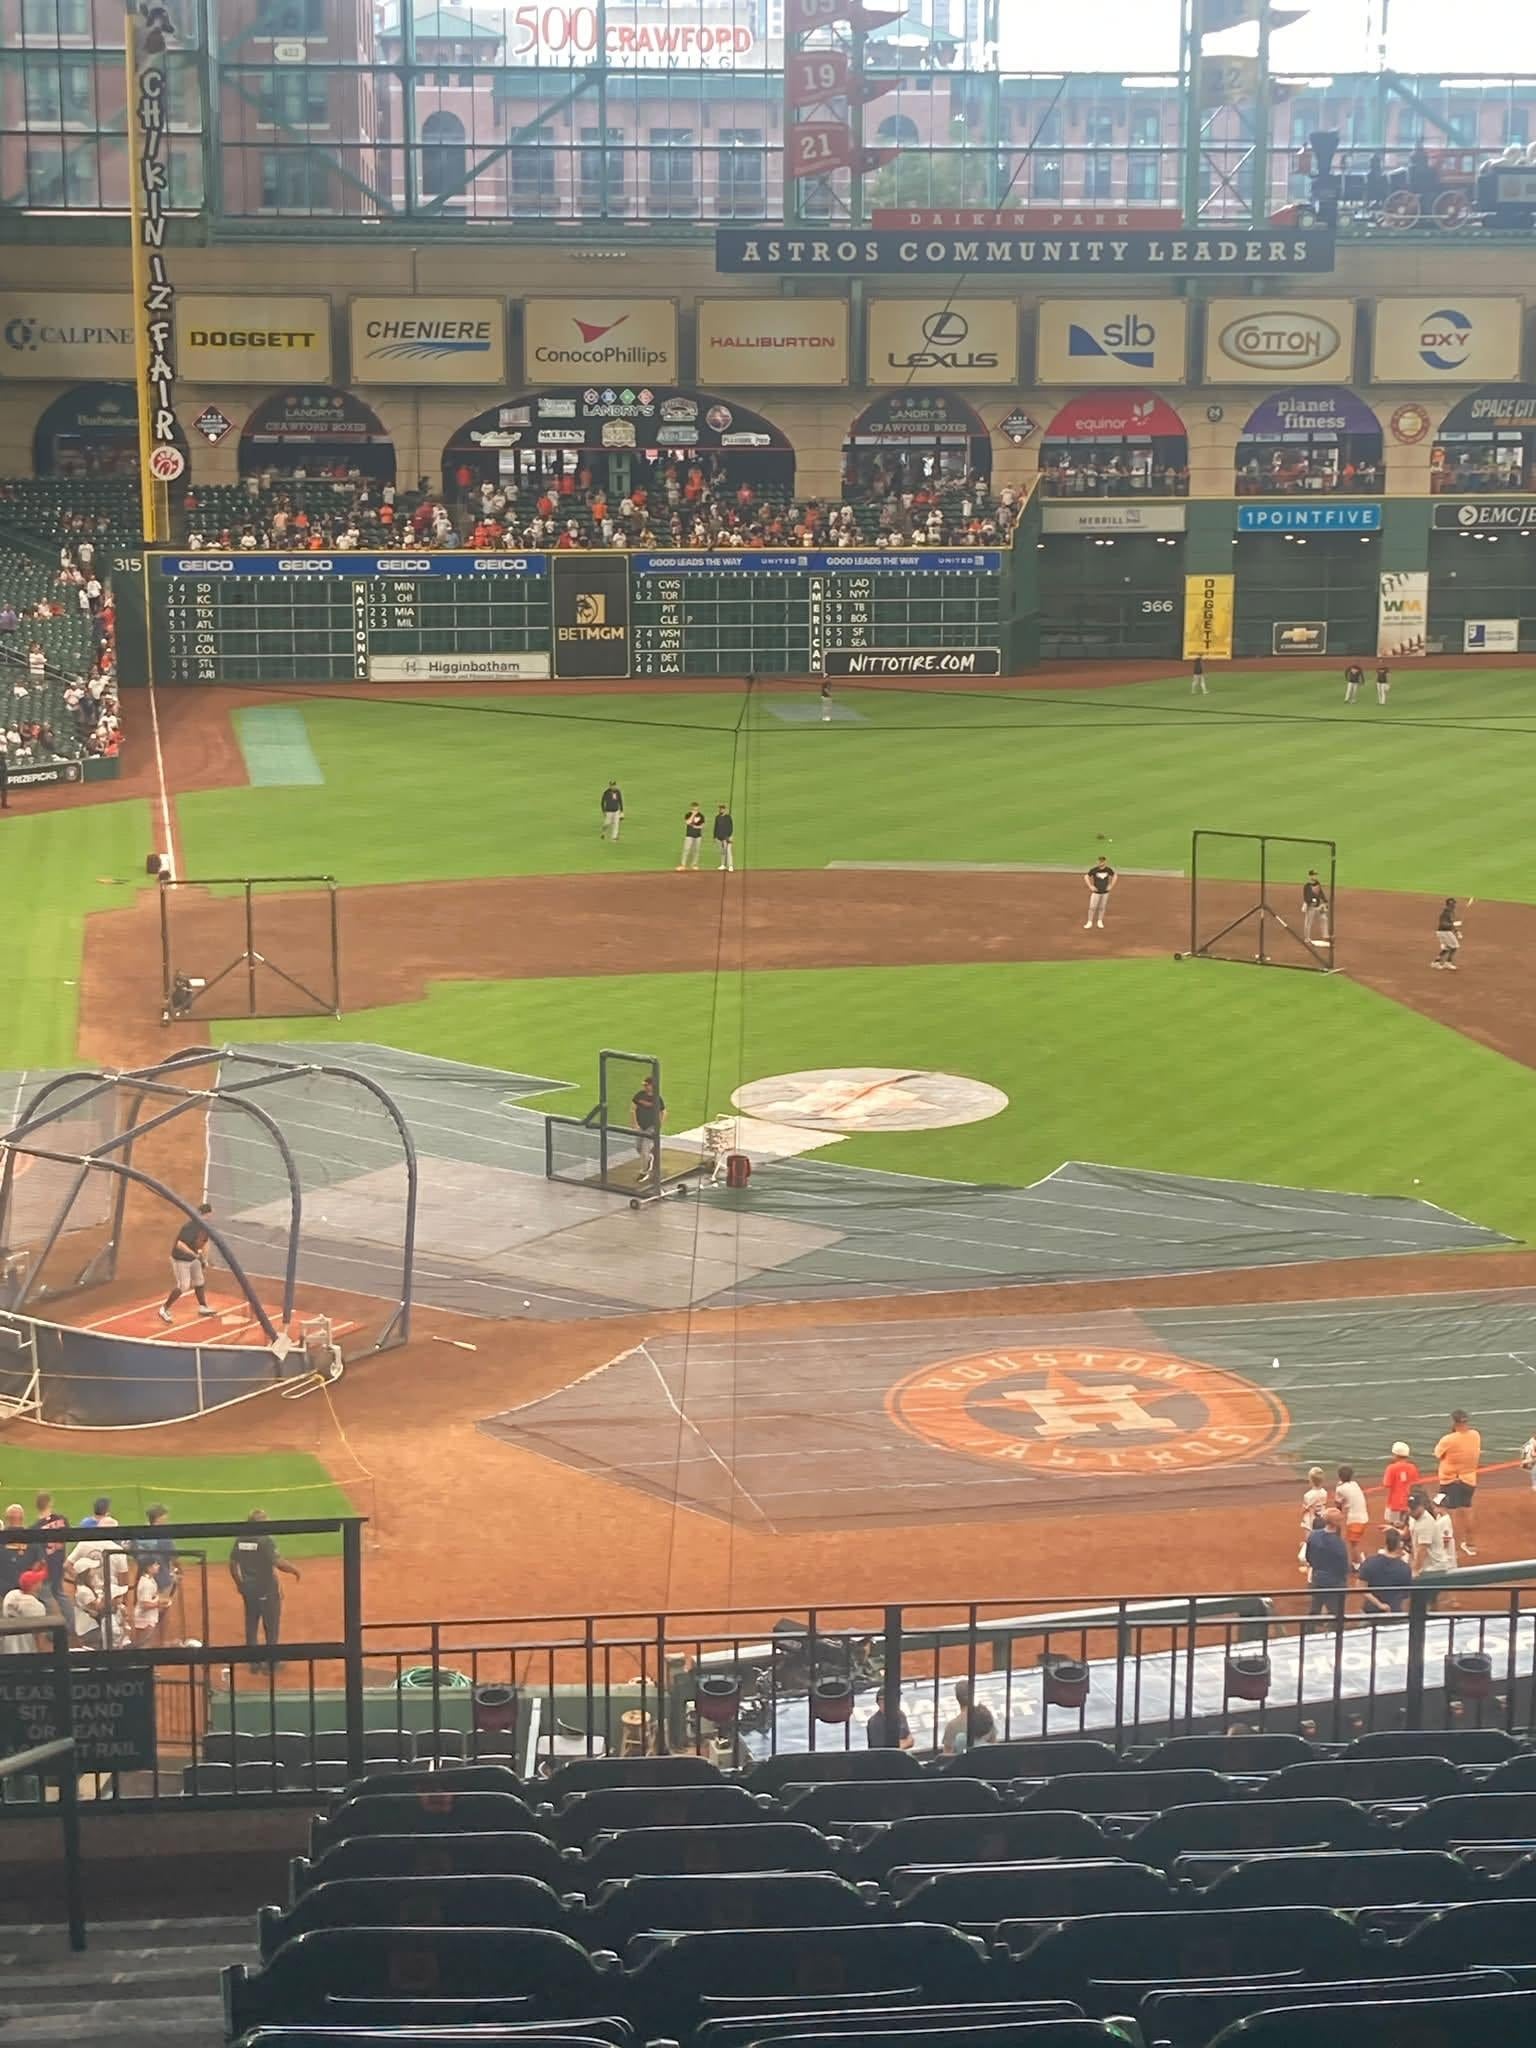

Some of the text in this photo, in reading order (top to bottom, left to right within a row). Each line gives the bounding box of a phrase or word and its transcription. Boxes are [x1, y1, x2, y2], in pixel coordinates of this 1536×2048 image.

[514, 5, 752, 54] 500 CRAWFORD
[803, 63, 835, 90] 19
[800, 133, 833, 160] 21
[141, 70, 166, 248] CHIKIN
[910, 213, 1130, 226] DAIKIN PARK
[742, 241, 1309, 262] ASTROS COMMUNITY LEADERS
[40, 327, 134, 344] CALPINE
[366, 321, 491, 339] CHENIERE
[1103, 314, 1156, 347] slb
[190, 331, 316, 348] DOGGETT
[710, 335, 836, 348] HALLIBURTON
[1233, 325, 1322, 357] COTTON
[1420, 332, 1469, 346] OXY
[535, 346, 668, 366] ConocoPhillips
[888, 352, 999, 369] LEXUS
[285, 408, 345, 419] LANDRY'S
[582, 404, 656, 417] LANDRY'S
[1277, 398, 1335, 417] planet
[1471, 400, 1514, 418] SPACE
[869, 423, 968, 432] CRAWFORD BOXES
[1075, 418, 1128, 432] equinor
[1284, 413, 1346, 430] fitness
[1246, 510, 1374, 525] 1POINTFIVE
[113, 558, 142, 572] 315
[178, 560, 234, 571] GEICO
[278, 560, 333, 571] GEICO
[377, 560, 431, 571] GEICO
[474, 559, 528, 570] GEICO
[649, 558, 676, 567] GOOD
[706, 558, 721, 567] THE
[722, 558, 742, 567] WAY
[826, 557, 853, 566] GOOD
[882, 557, 898, 566] THE
[899, 557, 920, 566] WAY
[938, 557, 974, 565] UNITED
[197, 583, 211, 593] SD
[394, 583, 415, 591] MIN
[658, 580, 681, 589] CWS
[849, 579, 869, 587] LAD
[197, 595, 212, 604] KC
[661, 591, 679, 600] TOR
[849, 590, 869, 599] NYY
[394, 607, 415, 616] MIA
[662, 605, 676, 614] PIT
[854, 603, 865, 612] TB
[1142, 600, 1174, 613] 366
[1384, 600, 1421, 612] WM
[196, 609, 214, 618] TEX
[850, 614, 868, 623] BOS
[1203, 578, 1216, 649] DOGGETT
[196, 620, 215, 630] ATL
[397, 618, 414, 627] MIL
[660, 616, 679, 625] CLE
[812, 580, 821, 671] AMERICAN
[355, 584, 367, 677] NATIONAL
[558, 627, 625, 641] BETMGM
[659, 629, 681, 638] WSH
[852, 627, 864, 636] SF
[198, 634, 214, 643] CIN
[660, 640, 680, 649] ATH
[850, 638, 867, 647] SEA
[195, 645, 217, 655] COL
[199, 659, 214, 668] STL
[661, 654, 678, 662] DET
[848, 653, 976, 673] NITTOTIRE.COM
[429, 661, 520, 673] Higginbotham
[660, 664, 680, 673] LAA
[198, 671, 216, 680] ARI
[7, 771, 58, 784] PRIZEPICKS
[922, 1350, 1197, 1393] HOUSTON
[1002, 1384, 1177, 1437] H
[993, 1428, 1251, 1468] ASTROS
[106, 1680, 145, 1698] NOT
